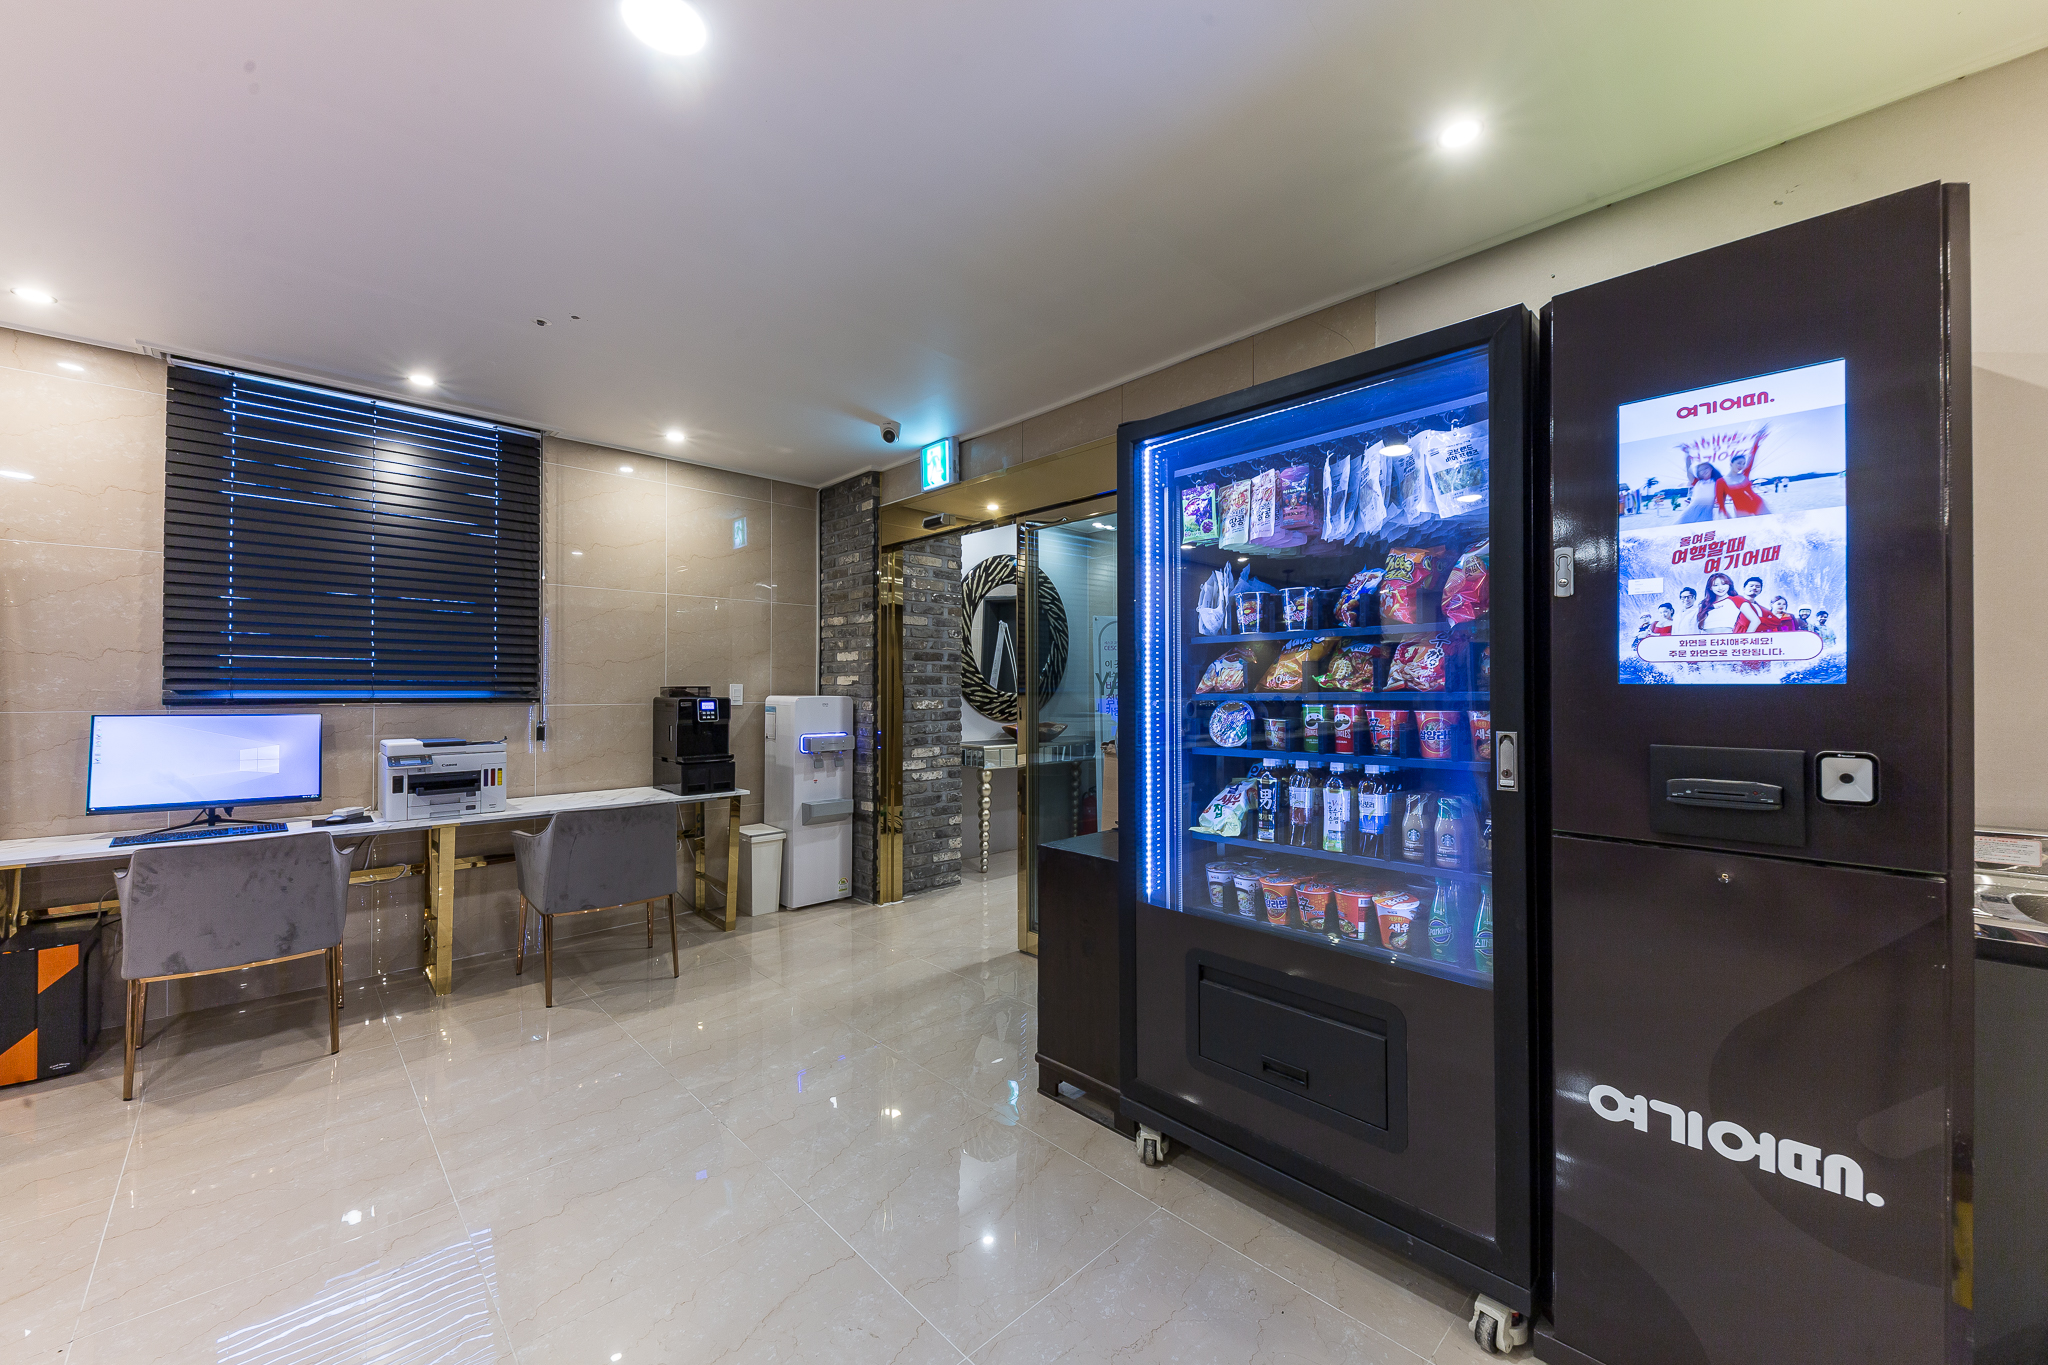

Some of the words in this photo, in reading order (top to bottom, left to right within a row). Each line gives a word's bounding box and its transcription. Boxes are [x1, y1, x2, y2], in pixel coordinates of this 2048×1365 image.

[1672, 536, 1746, 564] 여행할때
[1704, 545, 1781, 574] 여기어때
[1679, 638, 1707, 647] 화면을
[1669, 650, 1687, 658] 주문
[1690, 649, 1728, 657] 화면으로
